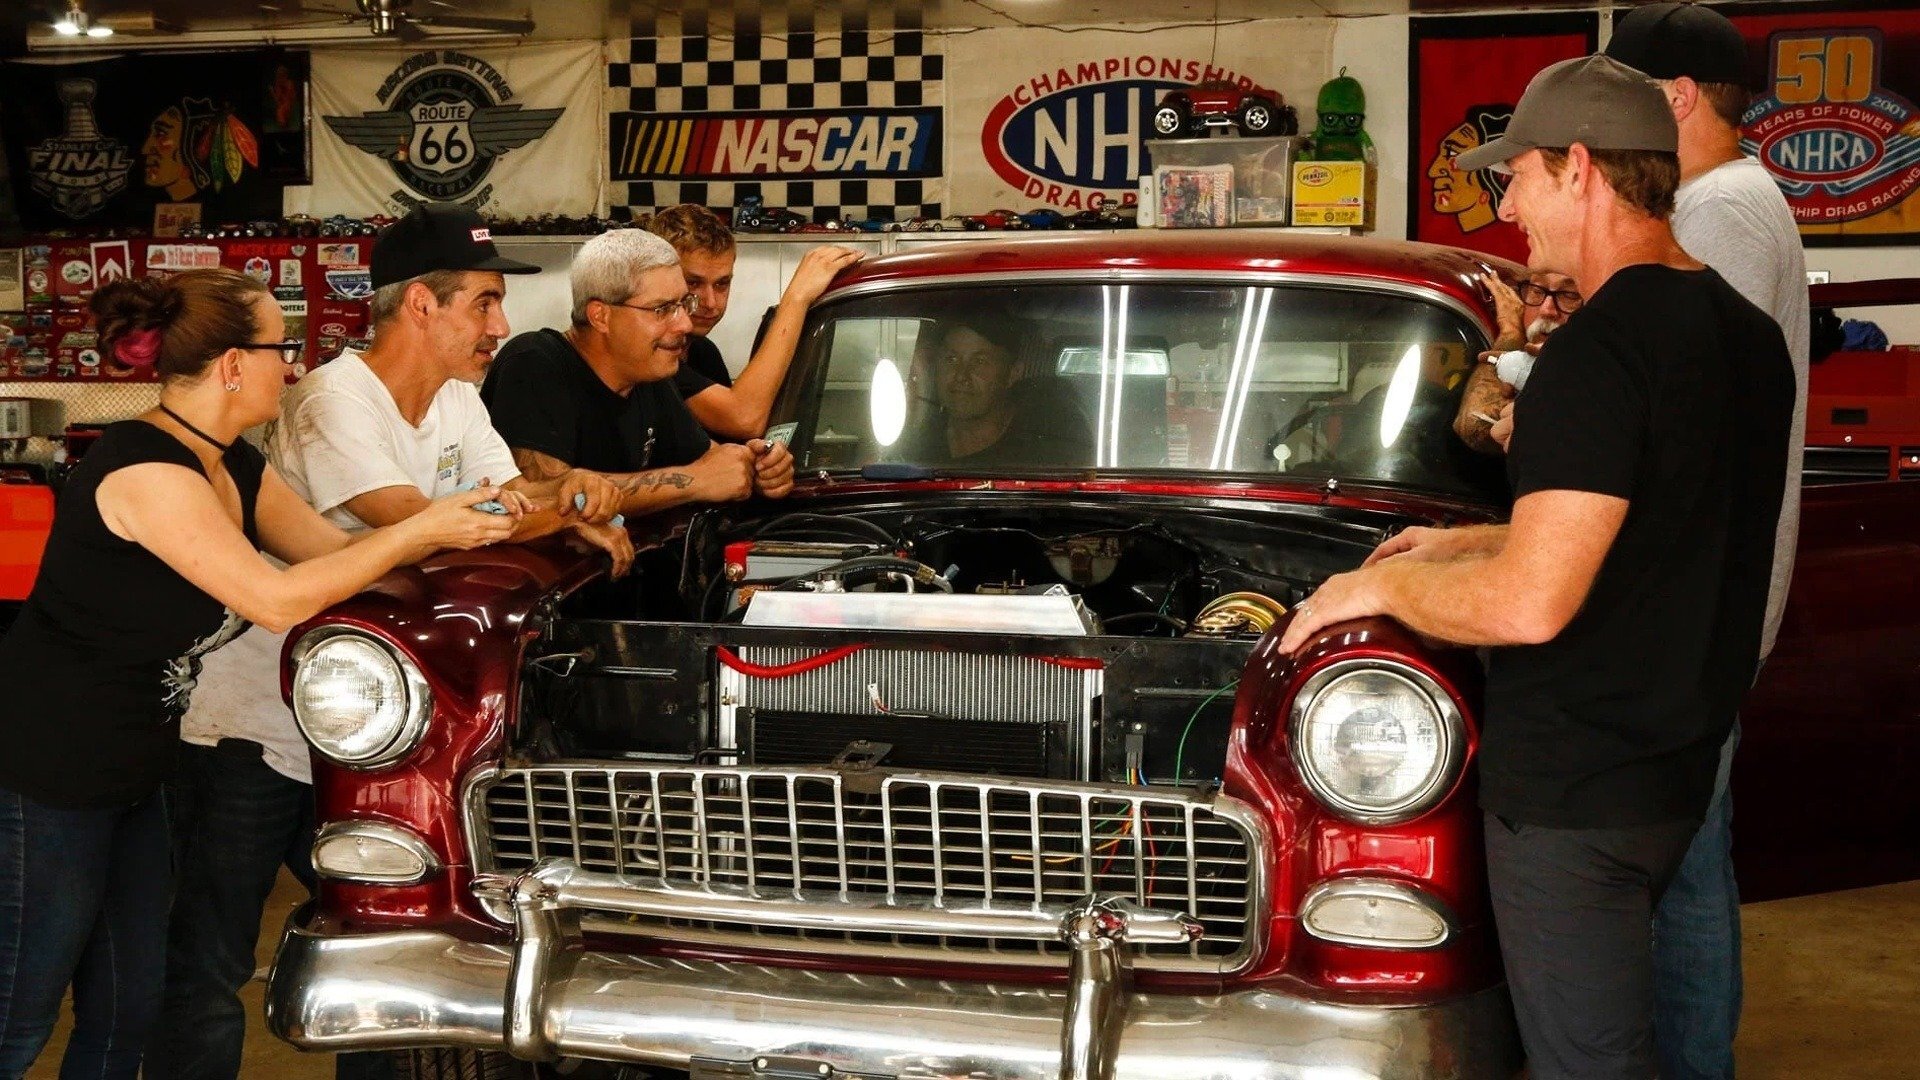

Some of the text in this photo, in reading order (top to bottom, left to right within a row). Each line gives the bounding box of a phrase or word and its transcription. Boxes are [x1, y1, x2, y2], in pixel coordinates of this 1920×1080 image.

[443, 50, 513, 103] SETTING
[1776, 36, 1873, 104] 50
[419, 106, 465, 120] ROUTE
[1742, 100, 1773, 124] 1951
[1753, 105, 1894, 135] YEARS OF POWER
[1870, 96, 1907, 119] 2001
[419, 125, 467, 165] 66
[711, 115, 919, 173] NASCAR
[1034, 87, 1178, 181] NH
[1779, 132, 1868, 171] NHRA
[29, 149, 130, 171] FINAL
[1024, 176, 1107, 211] DRAG
[1825, 201, 1869, 217] DRAG
[1871, 167, 1920, 208] RACING
